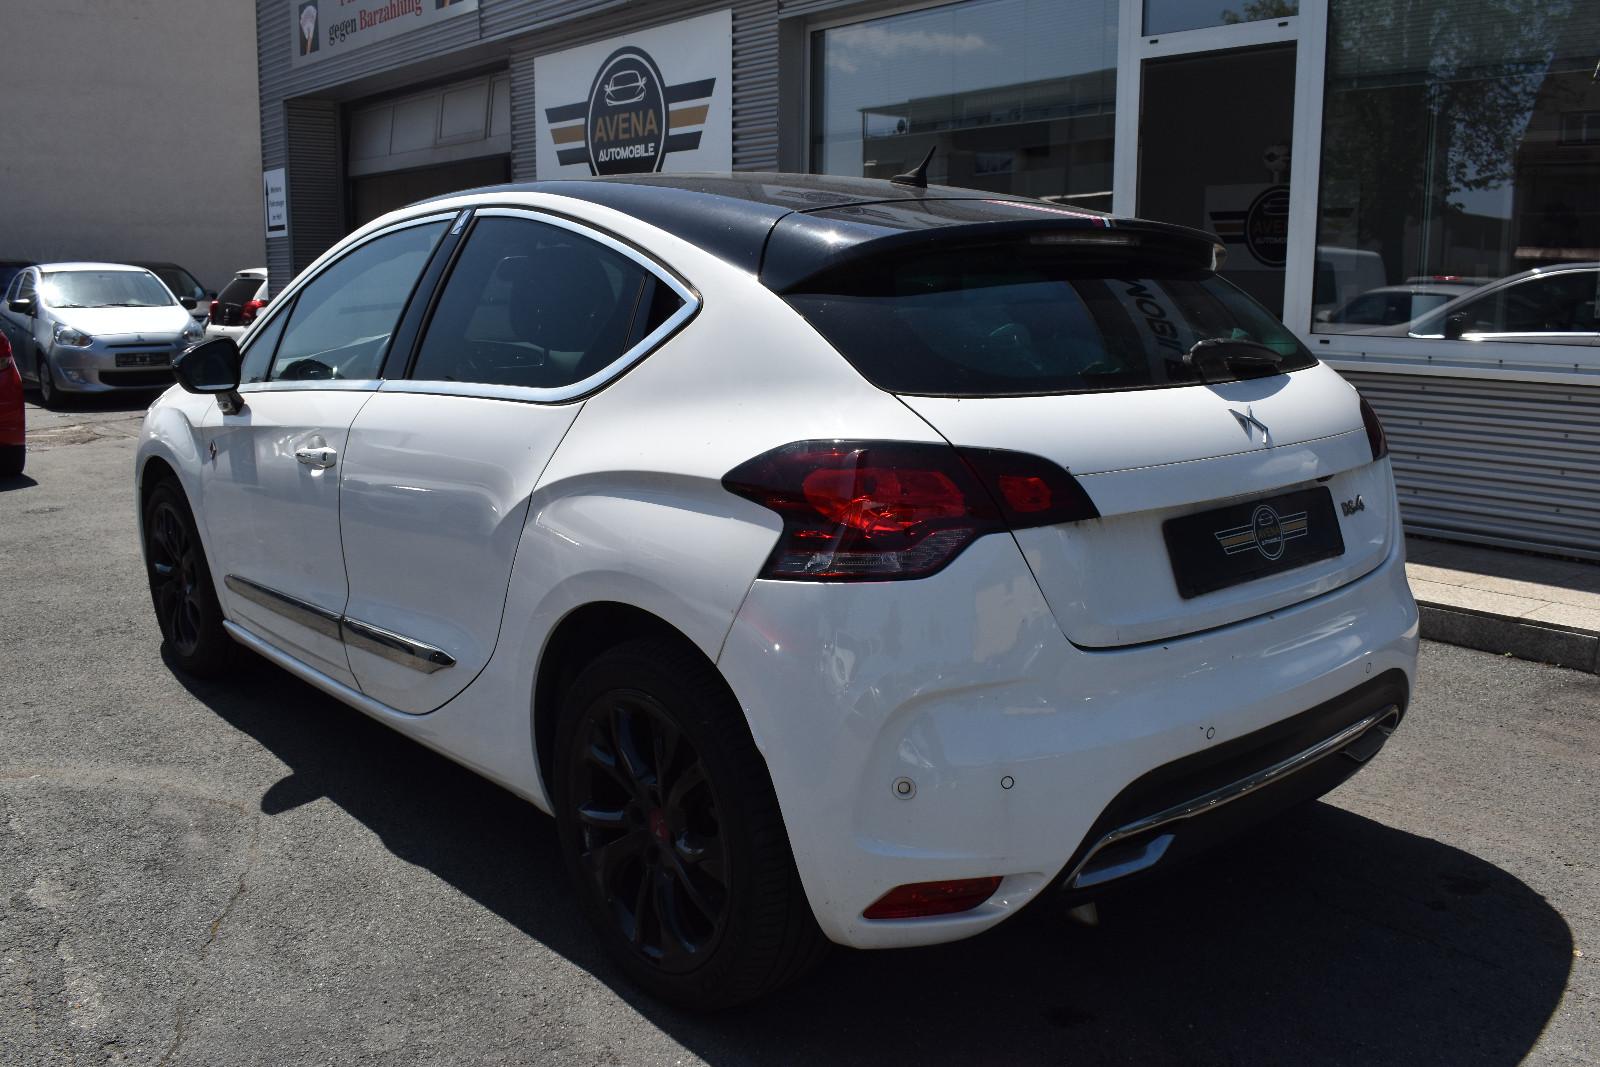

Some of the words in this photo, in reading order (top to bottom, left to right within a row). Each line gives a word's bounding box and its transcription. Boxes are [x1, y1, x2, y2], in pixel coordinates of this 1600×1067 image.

[328, 17, 357, 46] gegen
[359, 0, 422, 31] Barzahlung
[594, 108, 659, 143] AVENA
[598, 143, 655, 162] AUTOMOBILE
